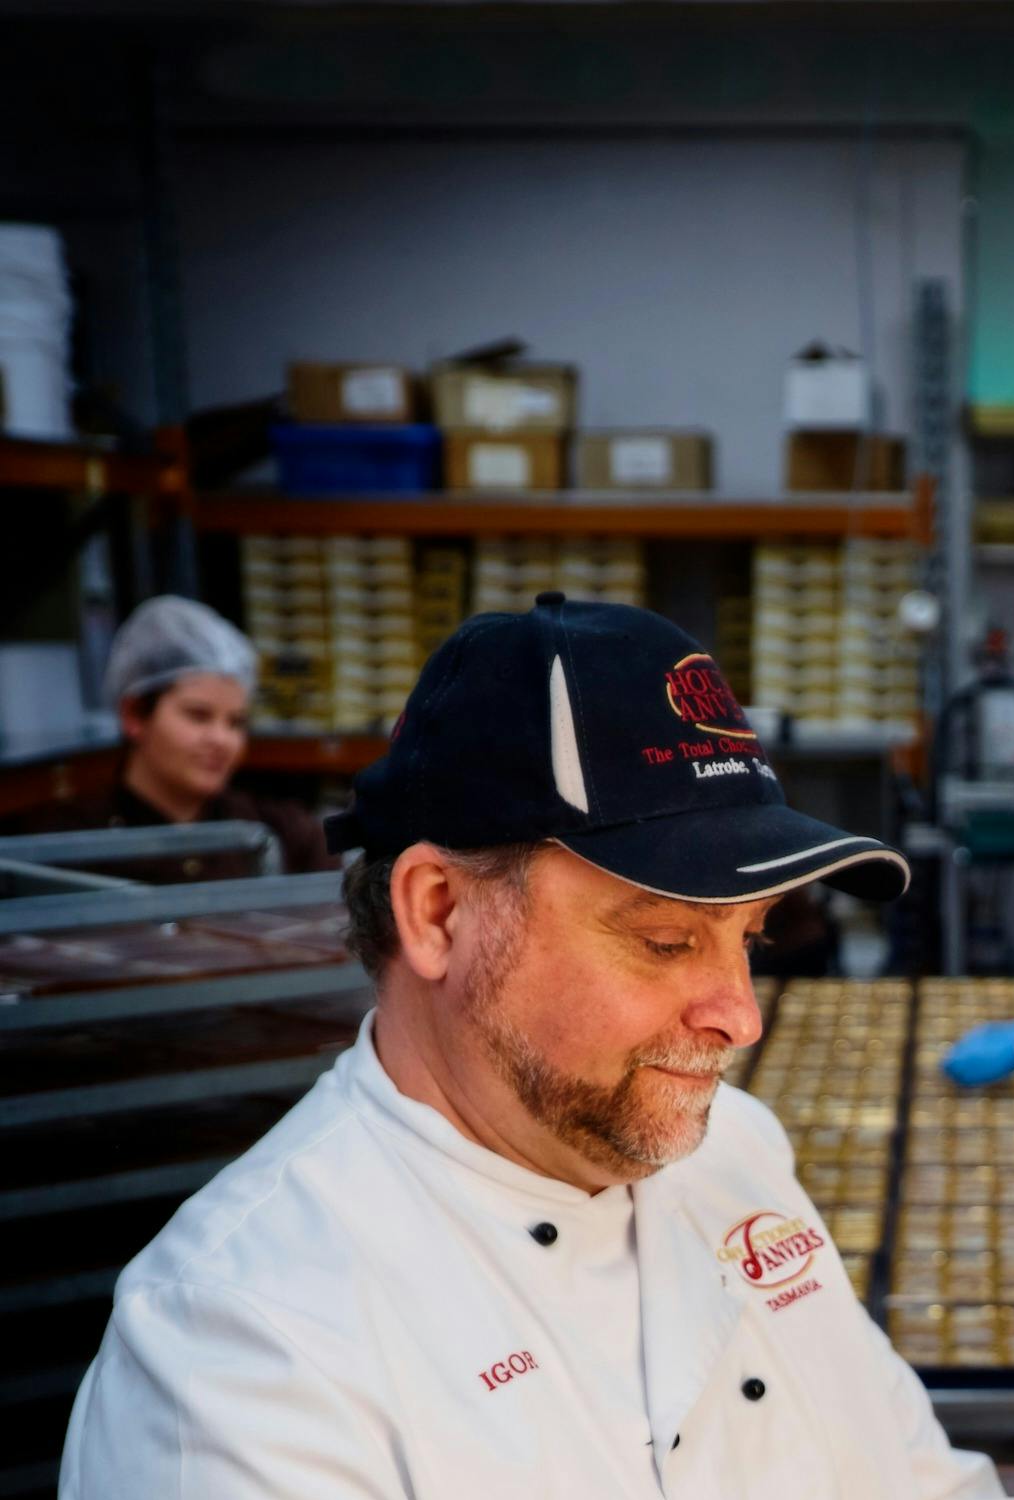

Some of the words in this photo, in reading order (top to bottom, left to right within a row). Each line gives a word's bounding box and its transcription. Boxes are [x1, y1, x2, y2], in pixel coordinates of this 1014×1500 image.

[642, 748, 674, 765] The
[679, 740, 715, 760] Total
[692, 757, 750, 779] Latrobe,
[479, 1351, 539, 1391] IGOR
